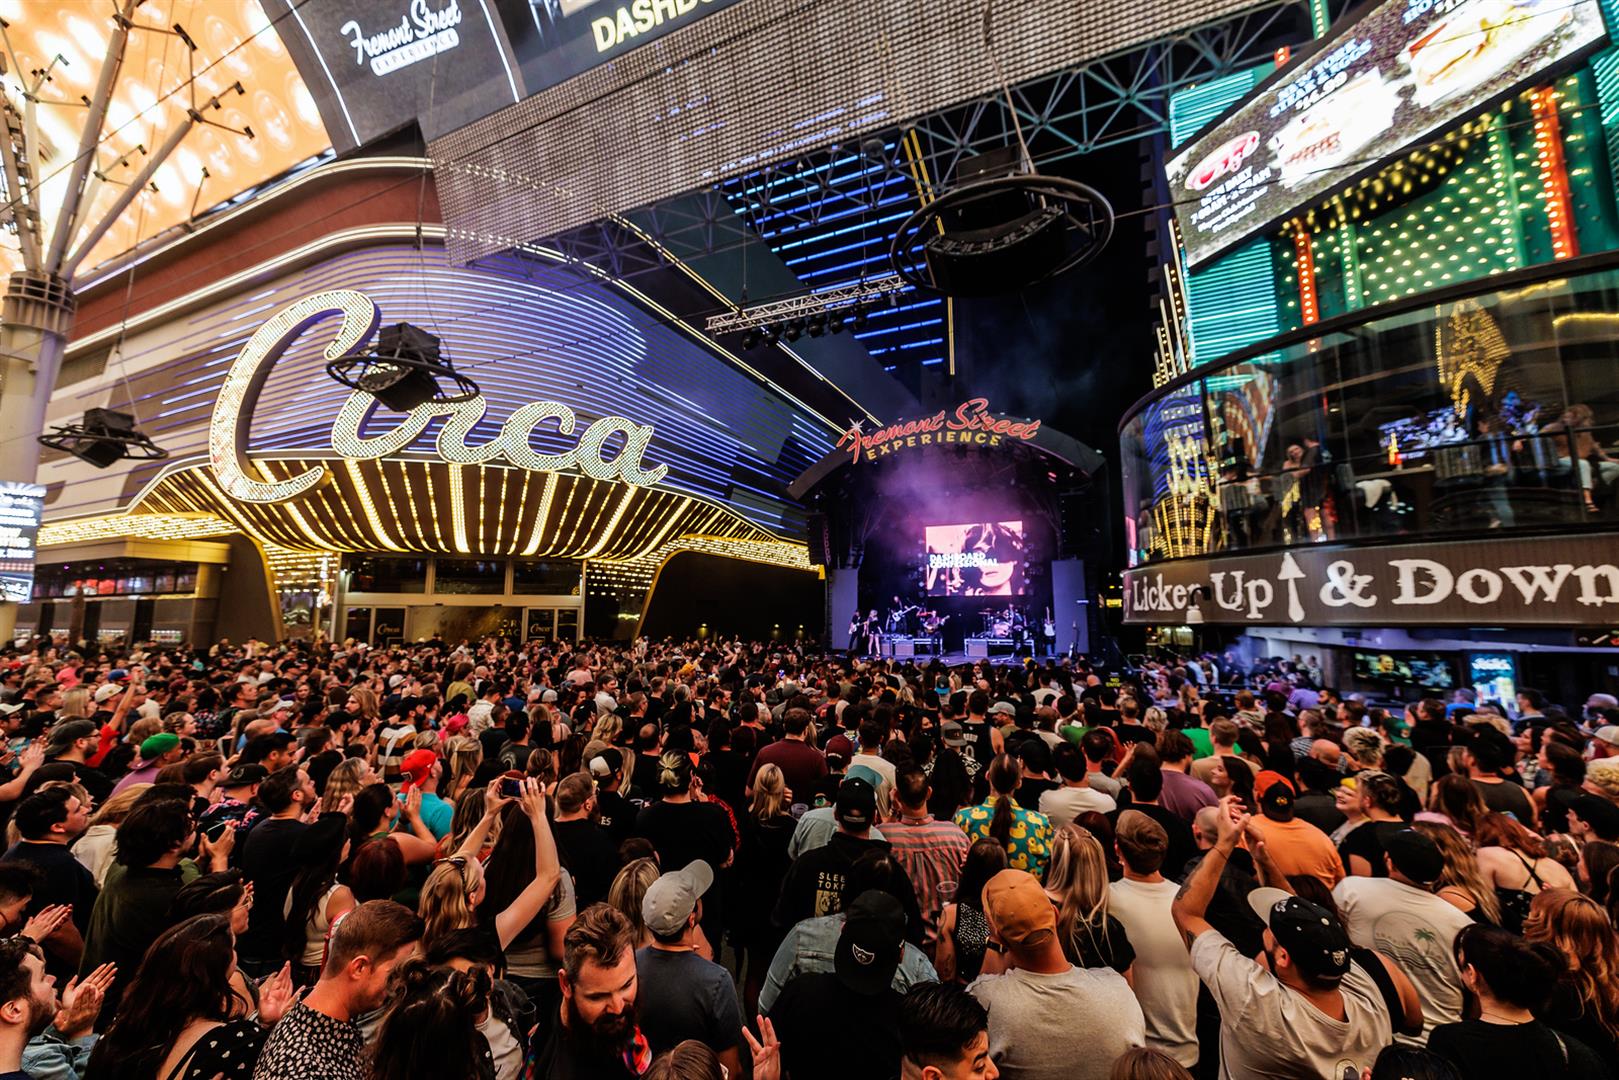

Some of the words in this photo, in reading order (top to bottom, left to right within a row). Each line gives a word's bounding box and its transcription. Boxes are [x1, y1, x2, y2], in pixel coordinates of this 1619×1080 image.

[340, 15, 413, 65] Fremont
[409, 0, 462, 39] Street
[1313, 38, 1357, 74] YORK
[209, 289, 668, 504] Circa
[836, 410, 946, 464] Fremont
[946, 397, 1041, 440] Street
[866, 431, 1002, 461] EXPERIENCE
[1210, 570, 1273, 620] Up
[1319, 560, 1377, 607] &
[1388, 558, 1619, 607] Down
[818, 871, 846, 883] SLEE
